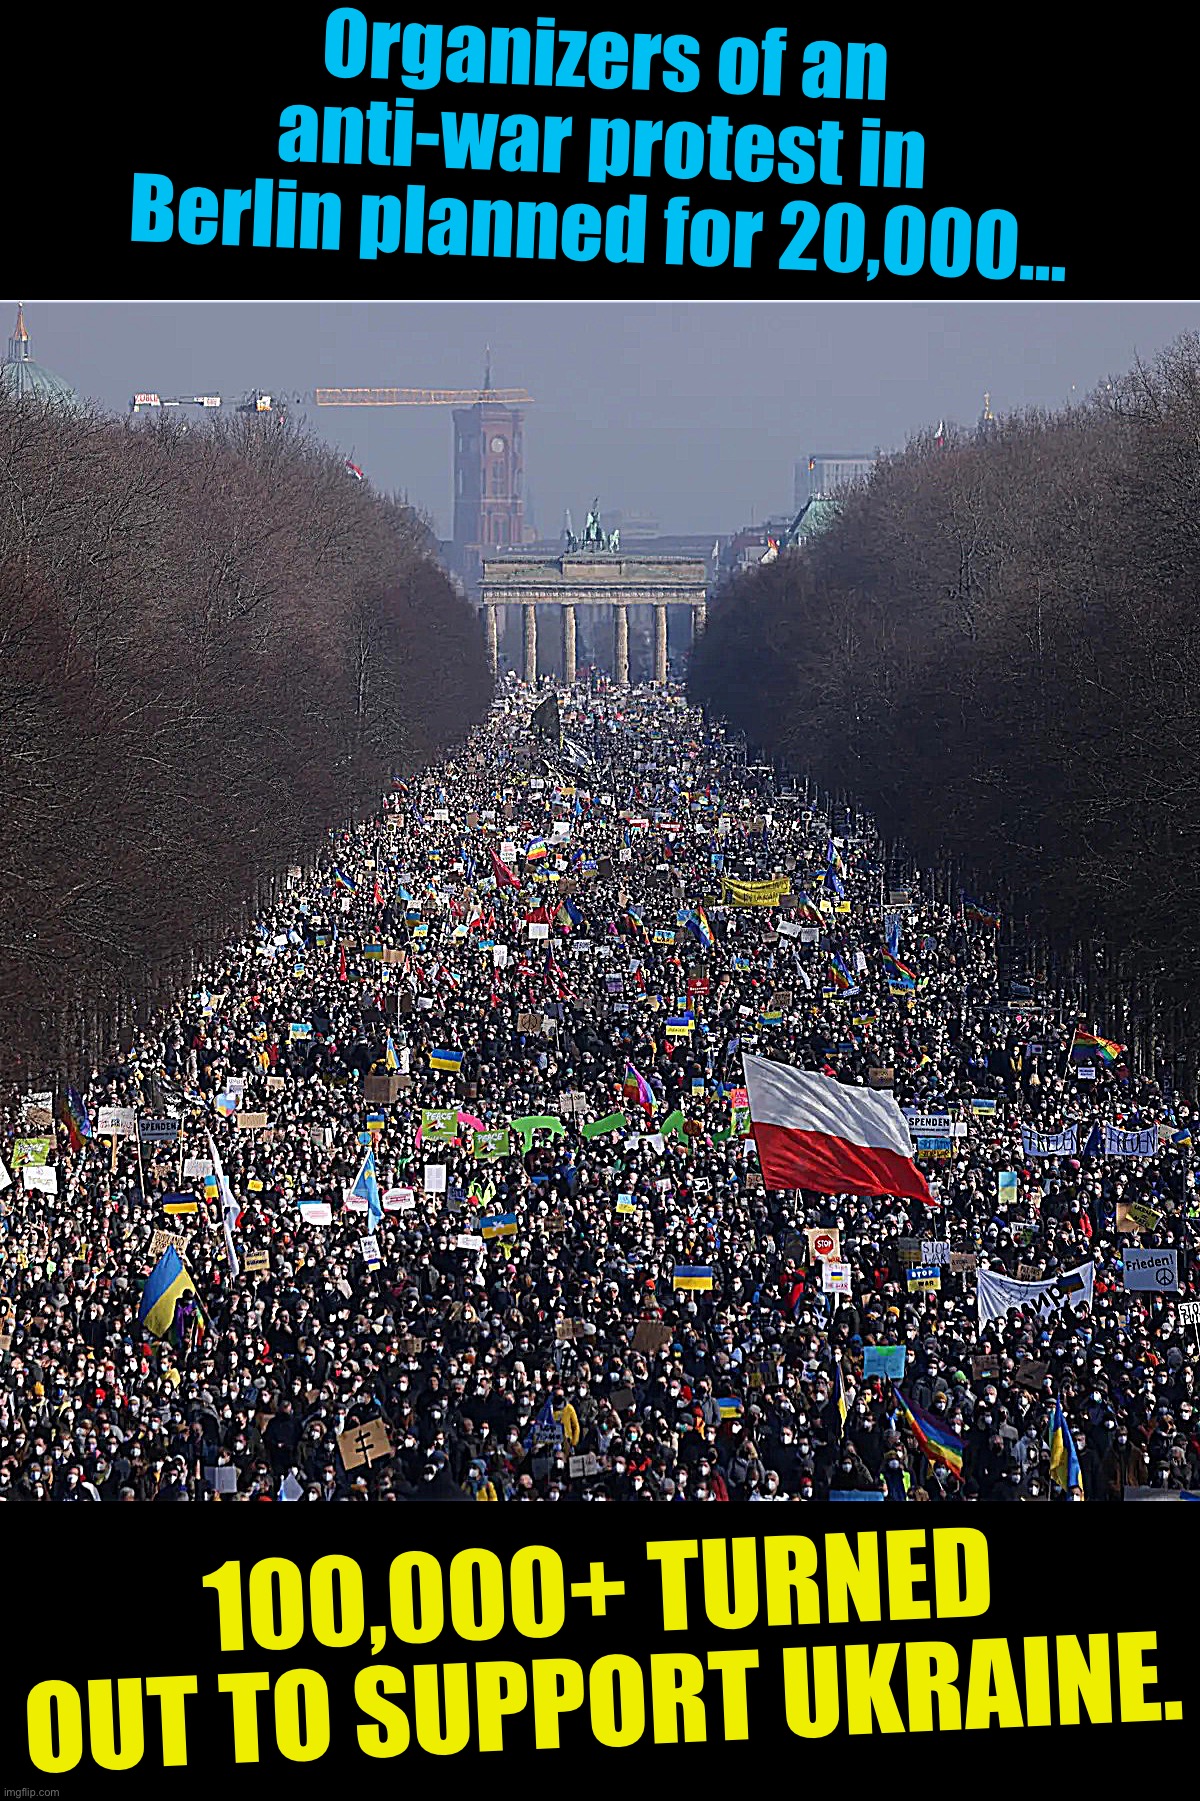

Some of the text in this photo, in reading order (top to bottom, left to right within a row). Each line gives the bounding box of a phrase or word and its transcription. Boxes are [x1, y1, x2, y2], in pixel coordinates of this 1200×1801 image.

[425, 1111, 455, 1121] PEACE
[140, 1122, 177, 1132] SPENDEN
[908, 1117, 950, 1127] SPENDEN
[477, 1131, 505, 1142] PEACE
[817, 1239, 832, 1248] STOP
[922, 1242, 949, 1254] STOP
[923, 1253, 946, 1264] WAR
[1126, 1254, 1174, 1271] Frieden!
[911, 1269, 933, 1278] STOP
[1179, 1303, 1200, 1315] STO
